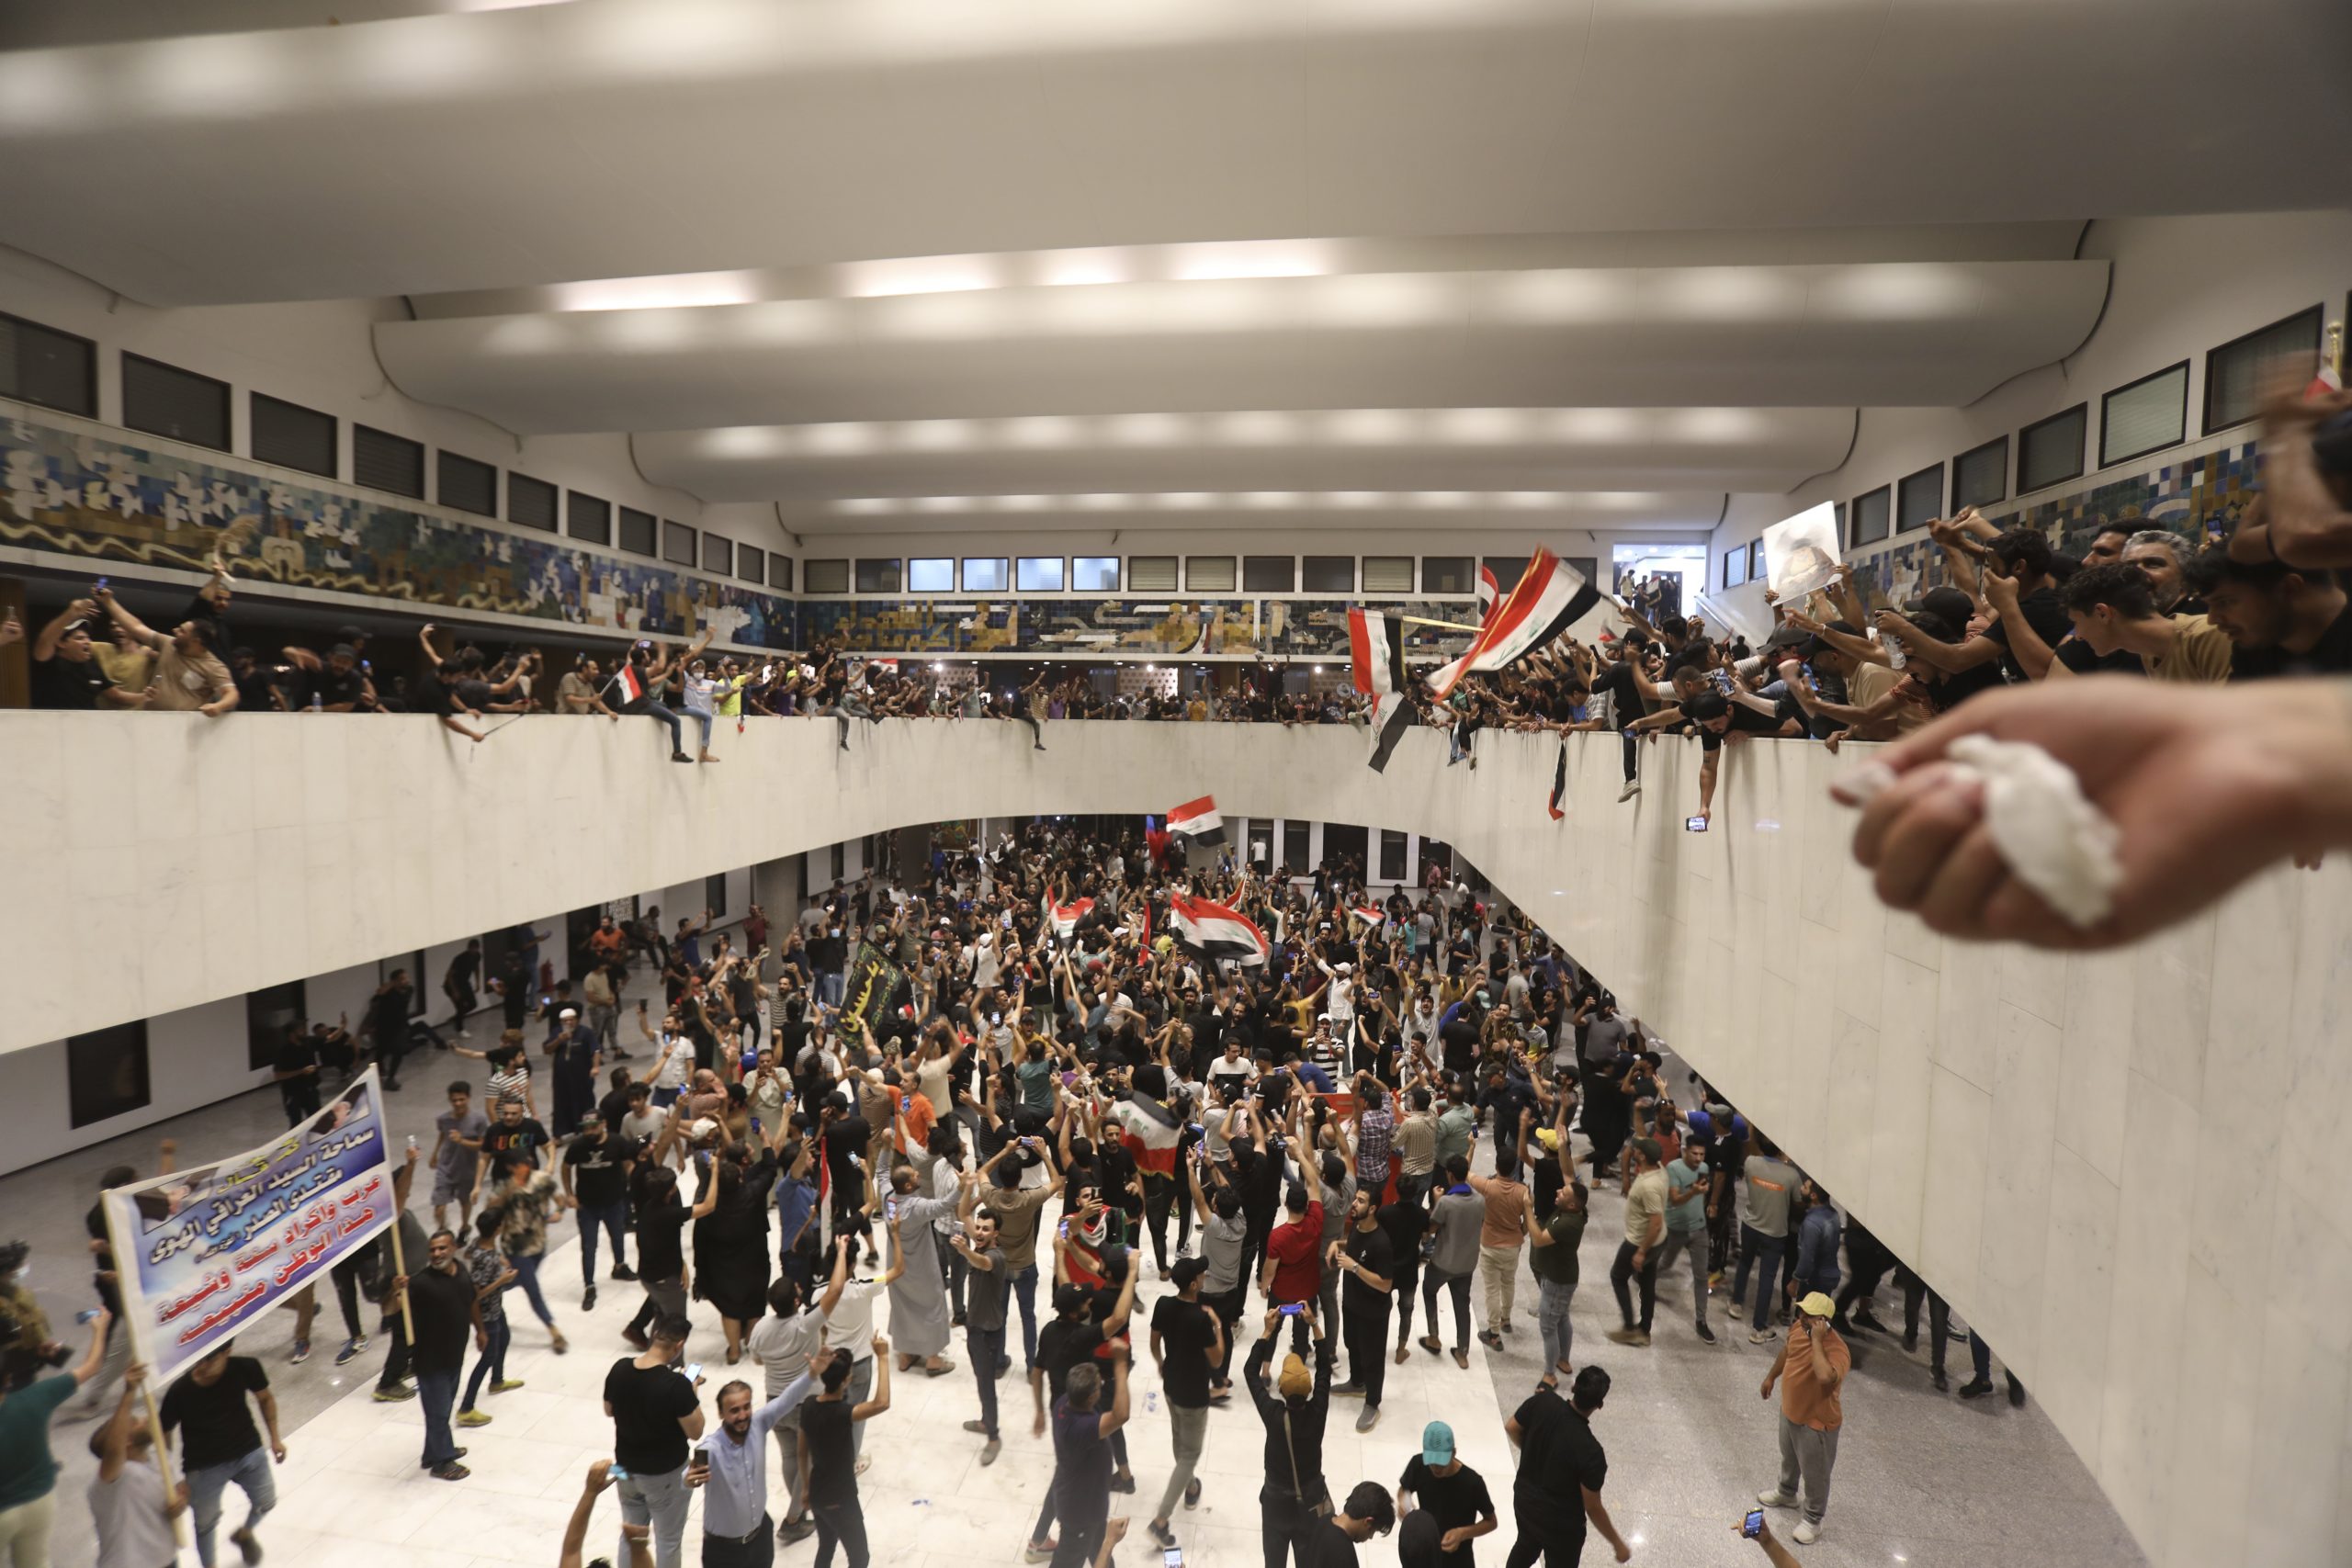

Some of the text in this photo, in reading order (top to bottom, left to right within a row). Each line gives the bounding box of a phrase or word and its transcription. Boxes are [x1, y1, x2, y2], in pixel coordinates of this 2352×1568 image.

[151, 1128, 375, 1265] سماحة السيد العراقي الهوى
[288, 1166, 345, 1211] مقتدى
[341, 1177, 380, 1207] عرب
[243, 1196, 287, 1242] الصدر
[337, 1207, 375, 1240] هذا
[233, 1239, 279, 1275] سنة
[274, 1229, 333, 1288] الوطن
